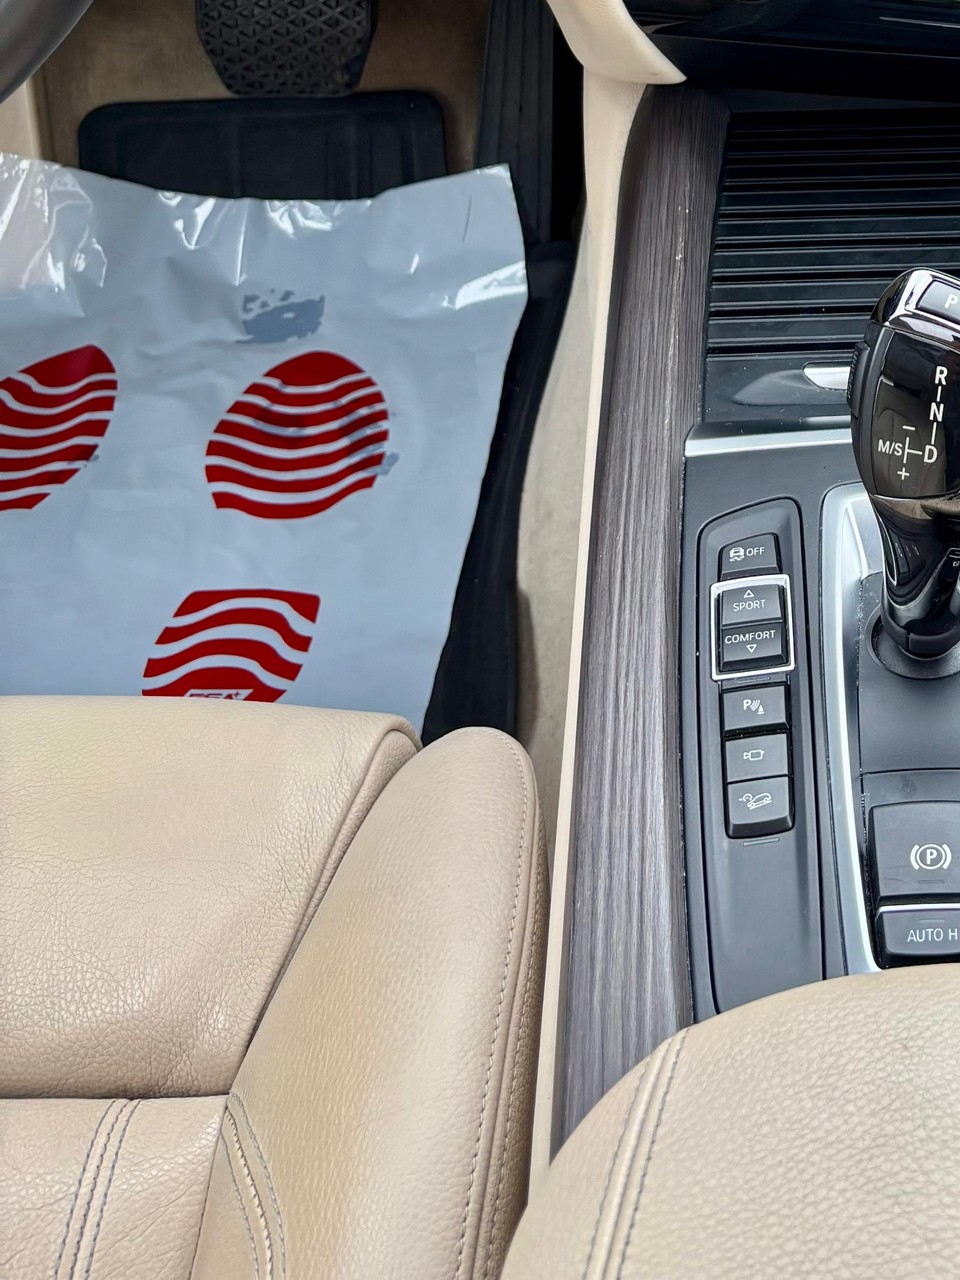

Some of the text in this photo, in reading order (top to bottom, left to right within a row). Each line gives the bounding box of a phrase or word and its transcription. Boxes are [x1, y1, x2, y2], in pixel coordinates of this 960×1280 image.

[944, 294, 959, 309] P
[935, 365, 948, 385] R
[929, 402, 944, 422] N
[878, 439, 938, 464] M/S D
[746, 546, 765, 557] OFF
[733, 599, 766, 611] SPORT
[725, 630, 776, 644] COMFORT
[907, 928, 958, 943] AUTO H
